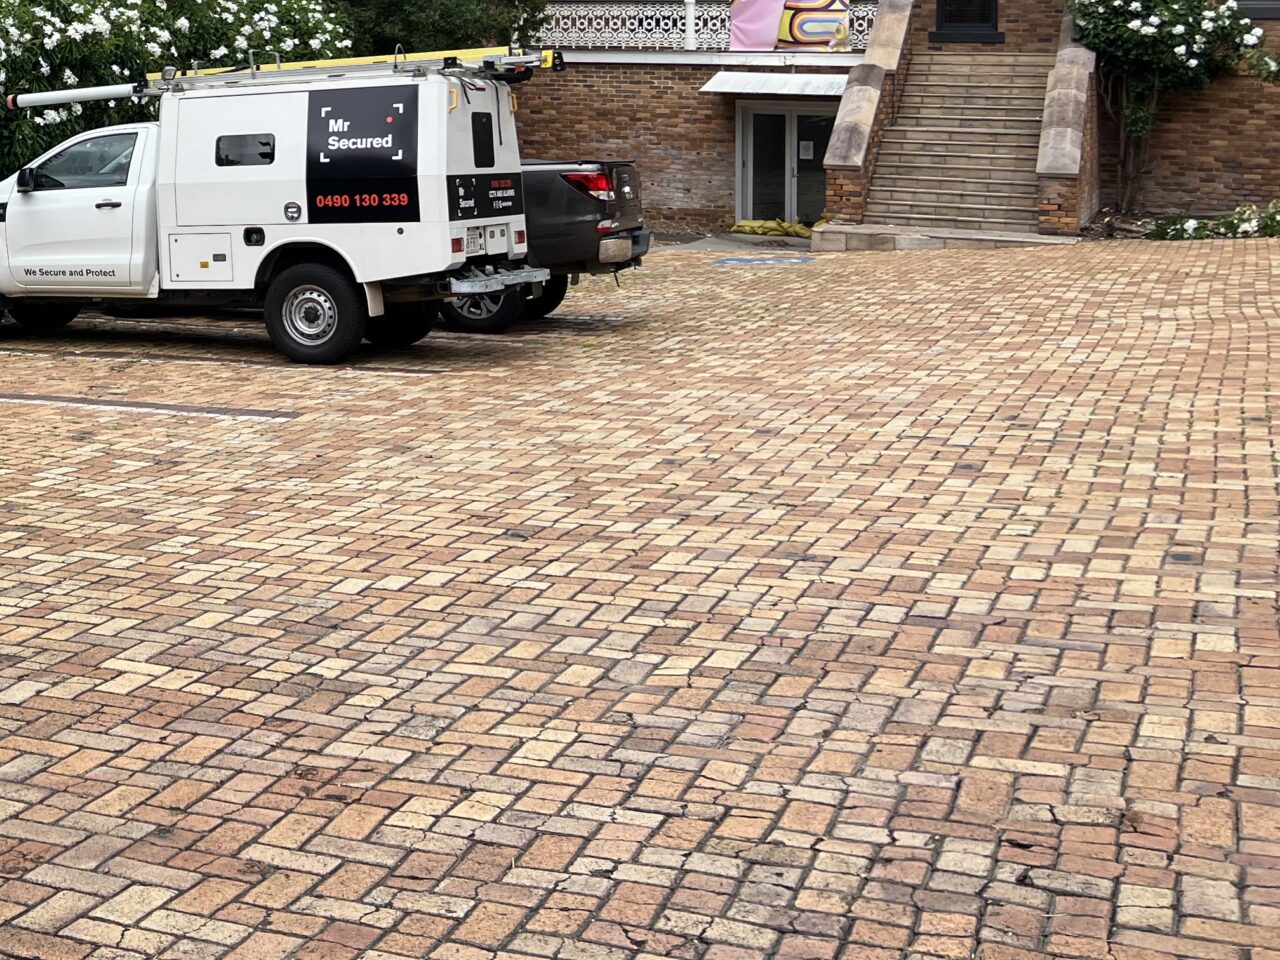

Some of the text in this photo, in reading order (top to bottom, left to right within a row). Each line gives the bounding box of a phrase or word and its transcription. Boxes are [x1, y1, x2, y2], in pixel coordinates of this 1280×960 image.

[328, 118, 350, 132] Mr
[327, 133, 393, 150] Secured
[458, 187, 465, 196] Mr
[316, 193, 409, 208] 0490 130 339
[23, 268, 116, 277] We Secure and Protect
